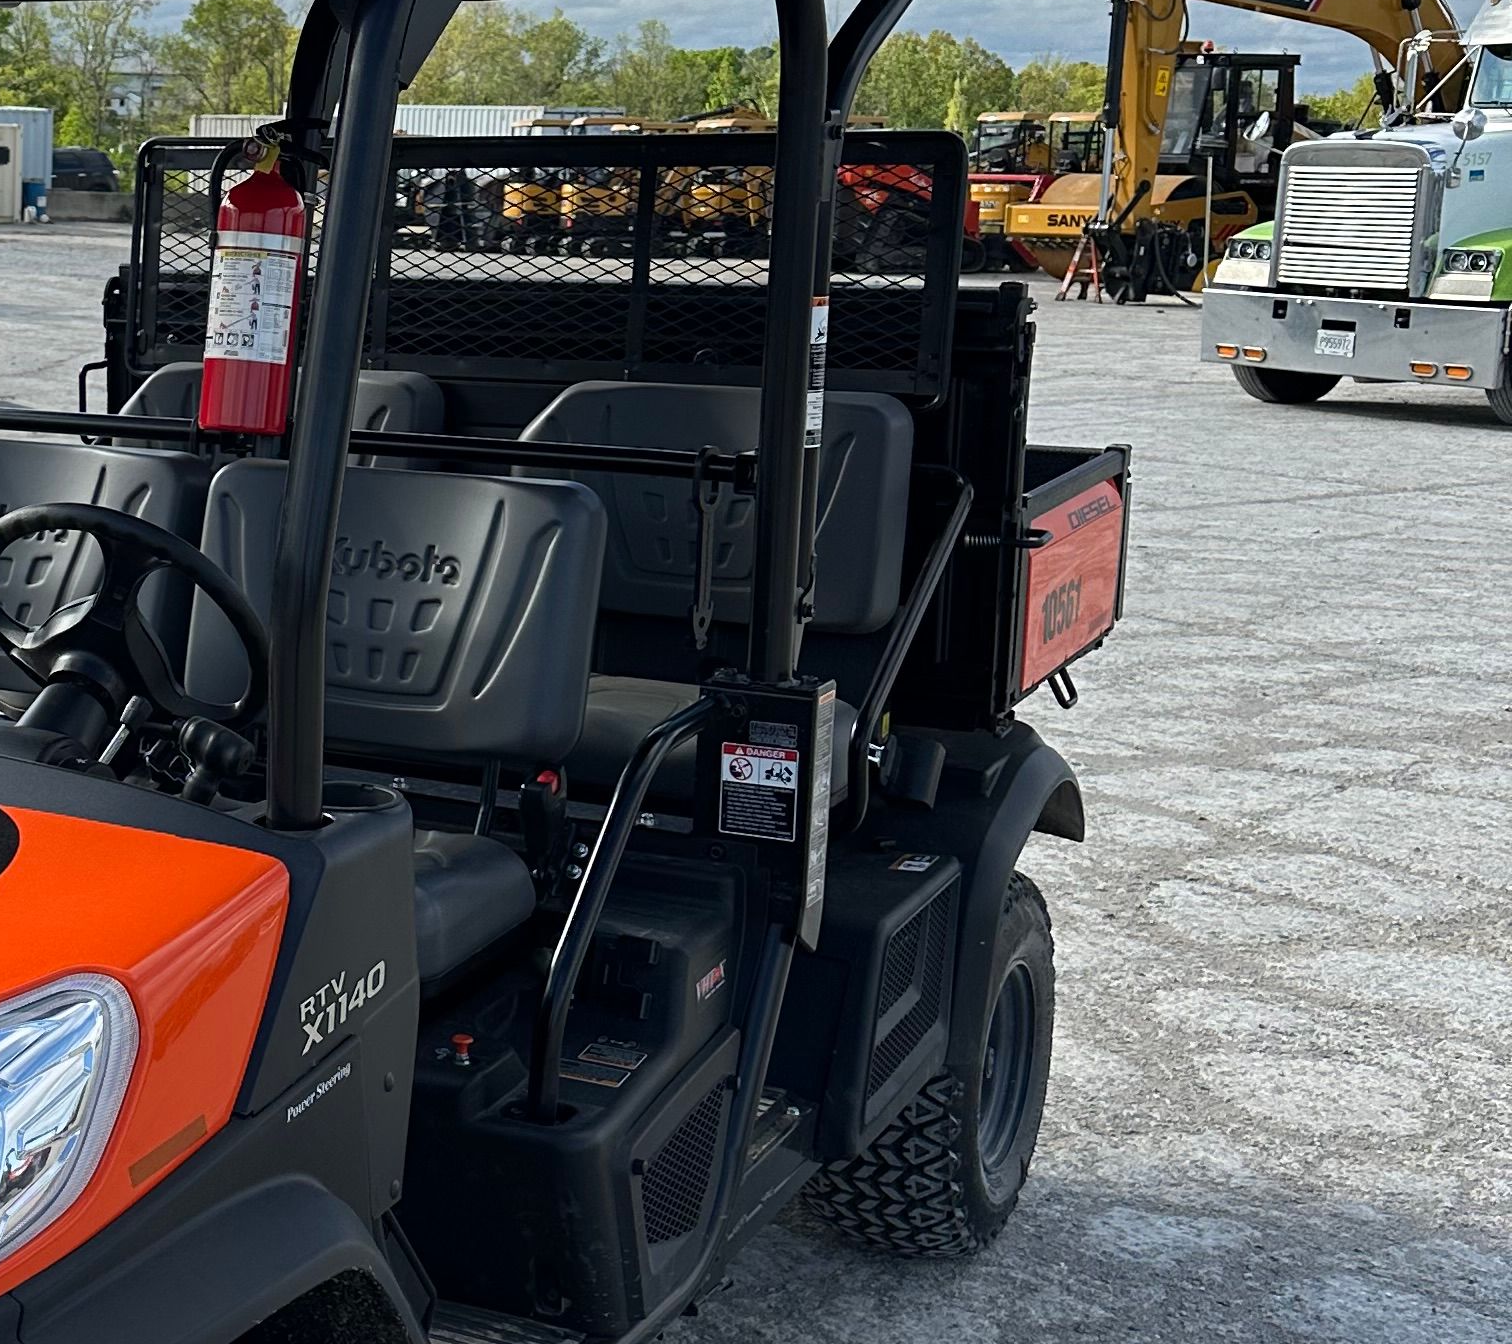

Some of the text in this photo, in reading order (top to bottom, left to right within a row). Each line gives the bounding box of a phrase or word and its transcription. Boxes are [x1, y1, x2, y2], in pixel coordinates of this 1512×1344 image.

[1462, 151, 1493, 167] 5157
[1047, 213, 1093, 228] SANY
[1067, 495, 1117, 531] DIESEL
[1041, 575, 1083, 645] 10561
[745, 747, 786, 759] DANGER
[299, 970, 346, 1023] RTV
[301, 959, 386, 1057] X1140
[286, 1062, 352, 1124] Power Steering
